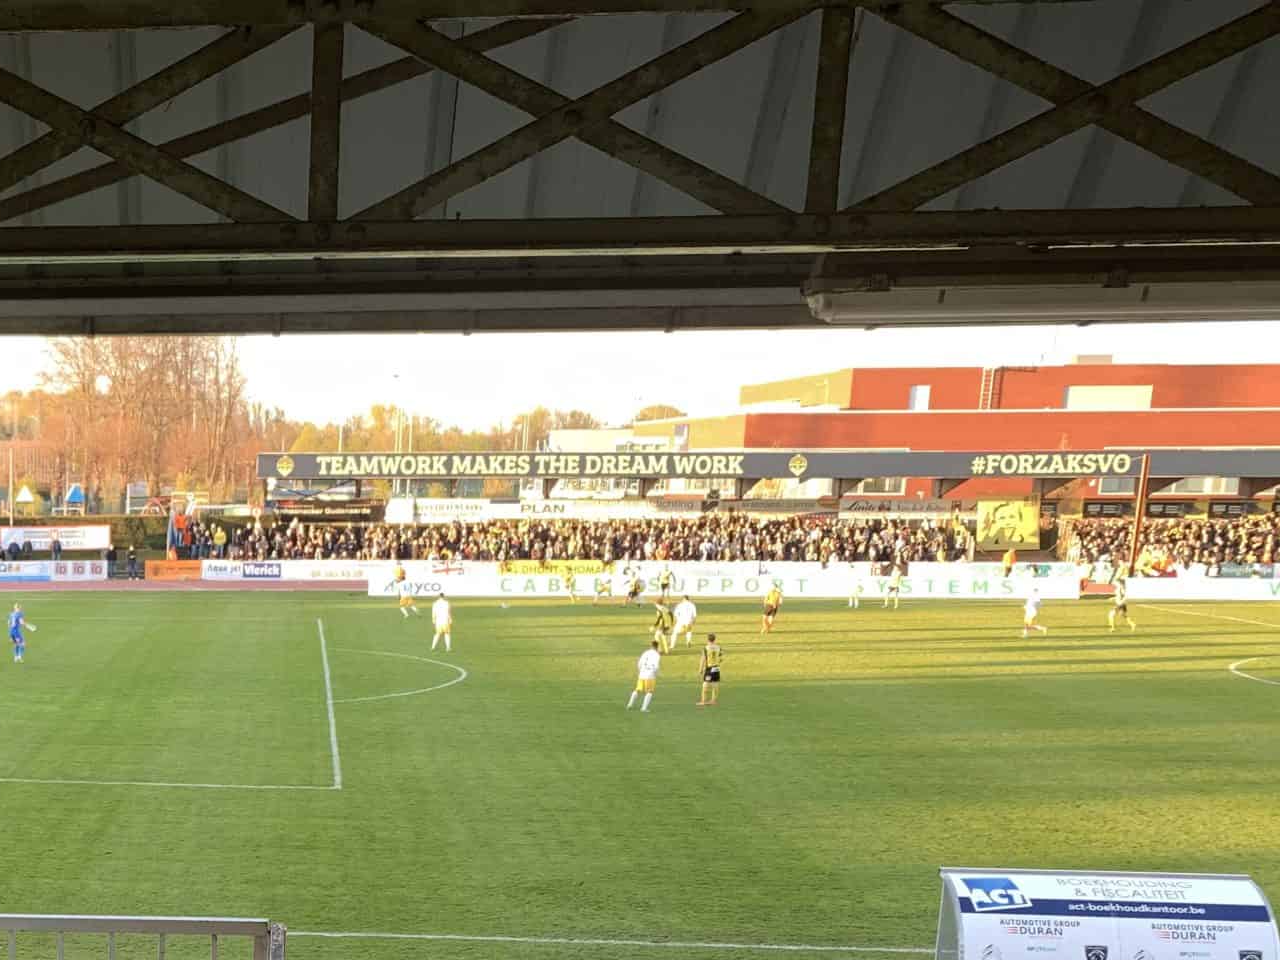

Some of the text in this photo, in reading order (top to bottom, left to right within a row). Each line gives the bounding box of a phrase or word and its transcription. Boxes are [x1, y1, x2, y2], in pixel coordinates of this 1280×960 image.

[316, 455, 745, 475] TEAMWORK MAKES THE DREAM WORK
[971, 454, 1131, 474] #FORZAKSVO
[970, 887, 1026, 905] ACT
[1068, 902, 1206, 915] act-boekhoudkantoor.be
[999, 919, 1081, 929] AUTOMOTIVE GROUP
[1151, 923, 1235, 934] AUTOMOTIVE GROUP
[1020, 926, 1064, 936] DURAN
[1171, 930, 1217, 941] DURAN
